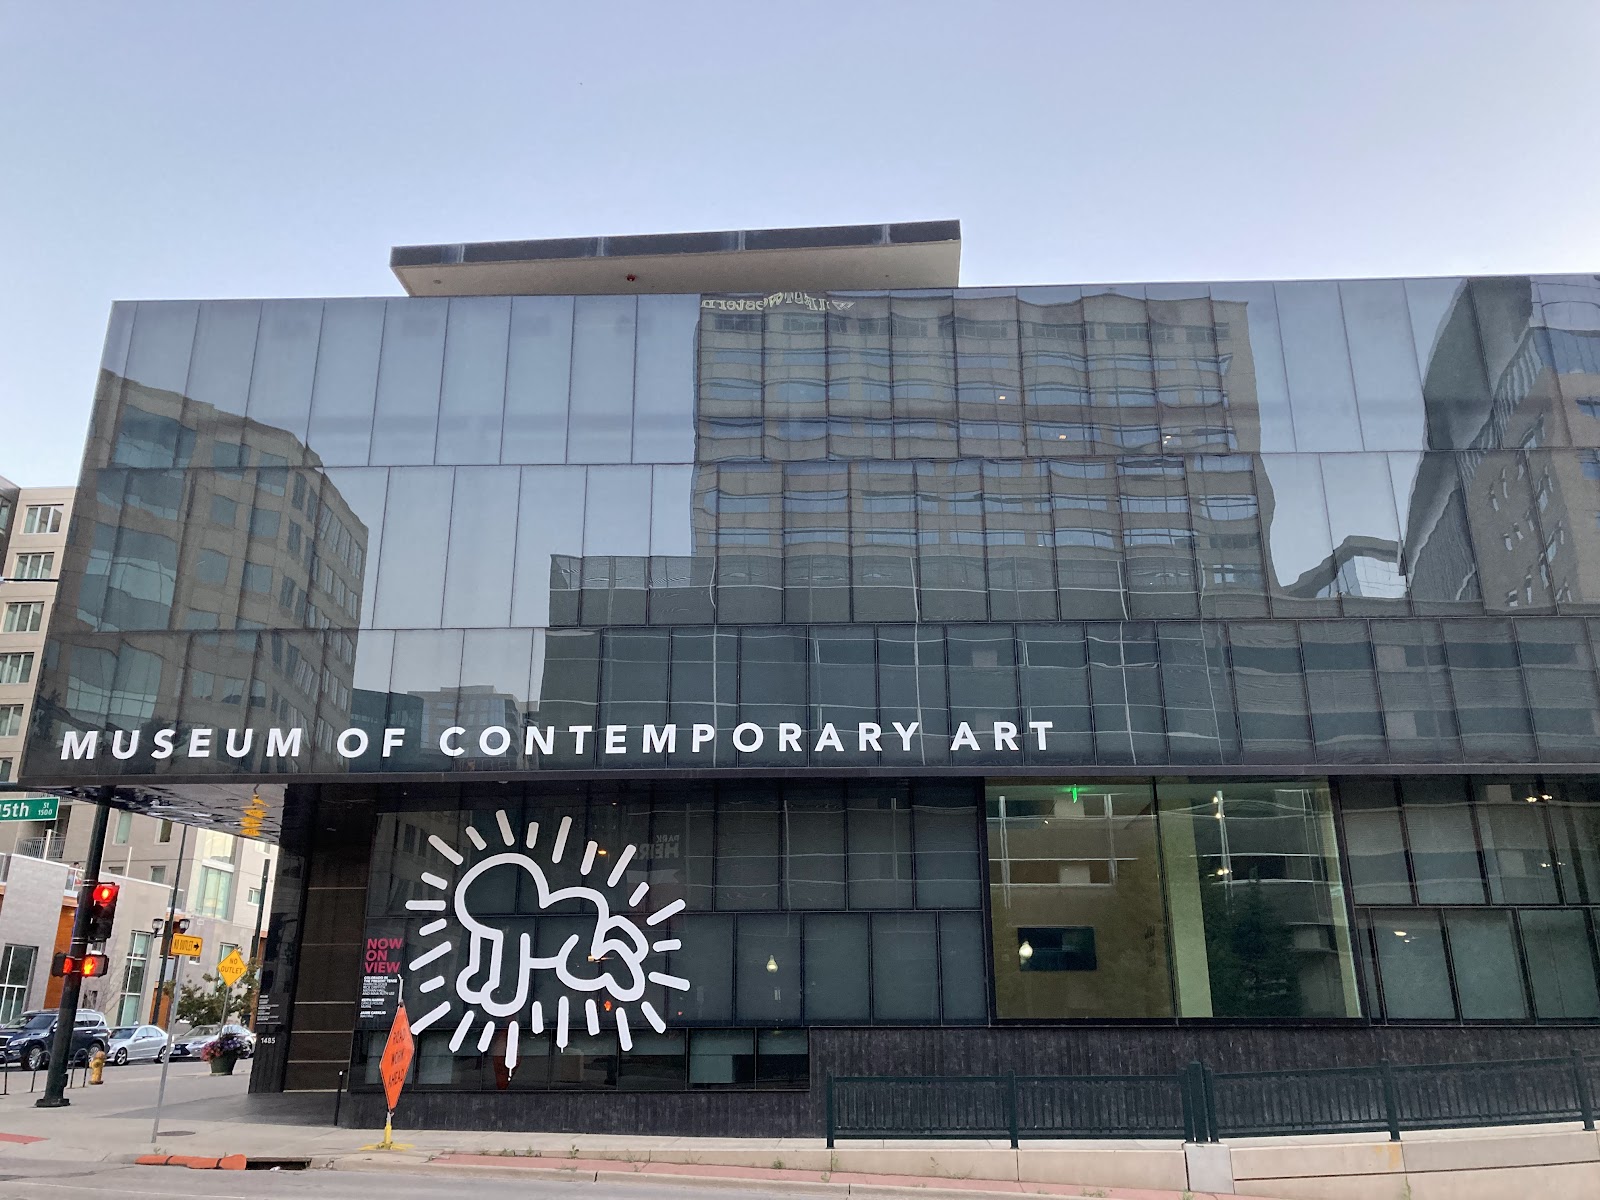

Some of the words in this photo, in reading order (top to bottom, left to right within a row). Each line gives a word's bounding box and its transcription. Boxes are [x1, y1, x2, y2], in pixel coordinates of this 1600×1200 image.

[60, 727, 302, 761] MUSEUM
[336, 725, 406, 758] OF
[439, 721, 921, 758] CONTEMPORARY
[950, 720, 1054, 752] ART
[180, 940, 194, 952] OUTLET
[367, 938, 402, 950] NOW
[366, 950, 388, 961] ON
[221, 966, 243, 974] OUTLET
[365, 961, 400, 973] VIEW
[260, 1037, 276, 1045] 1485
[393, 1028, 406, 1045] ROAD
[388, 1069, 405, 1088] AHEAD
